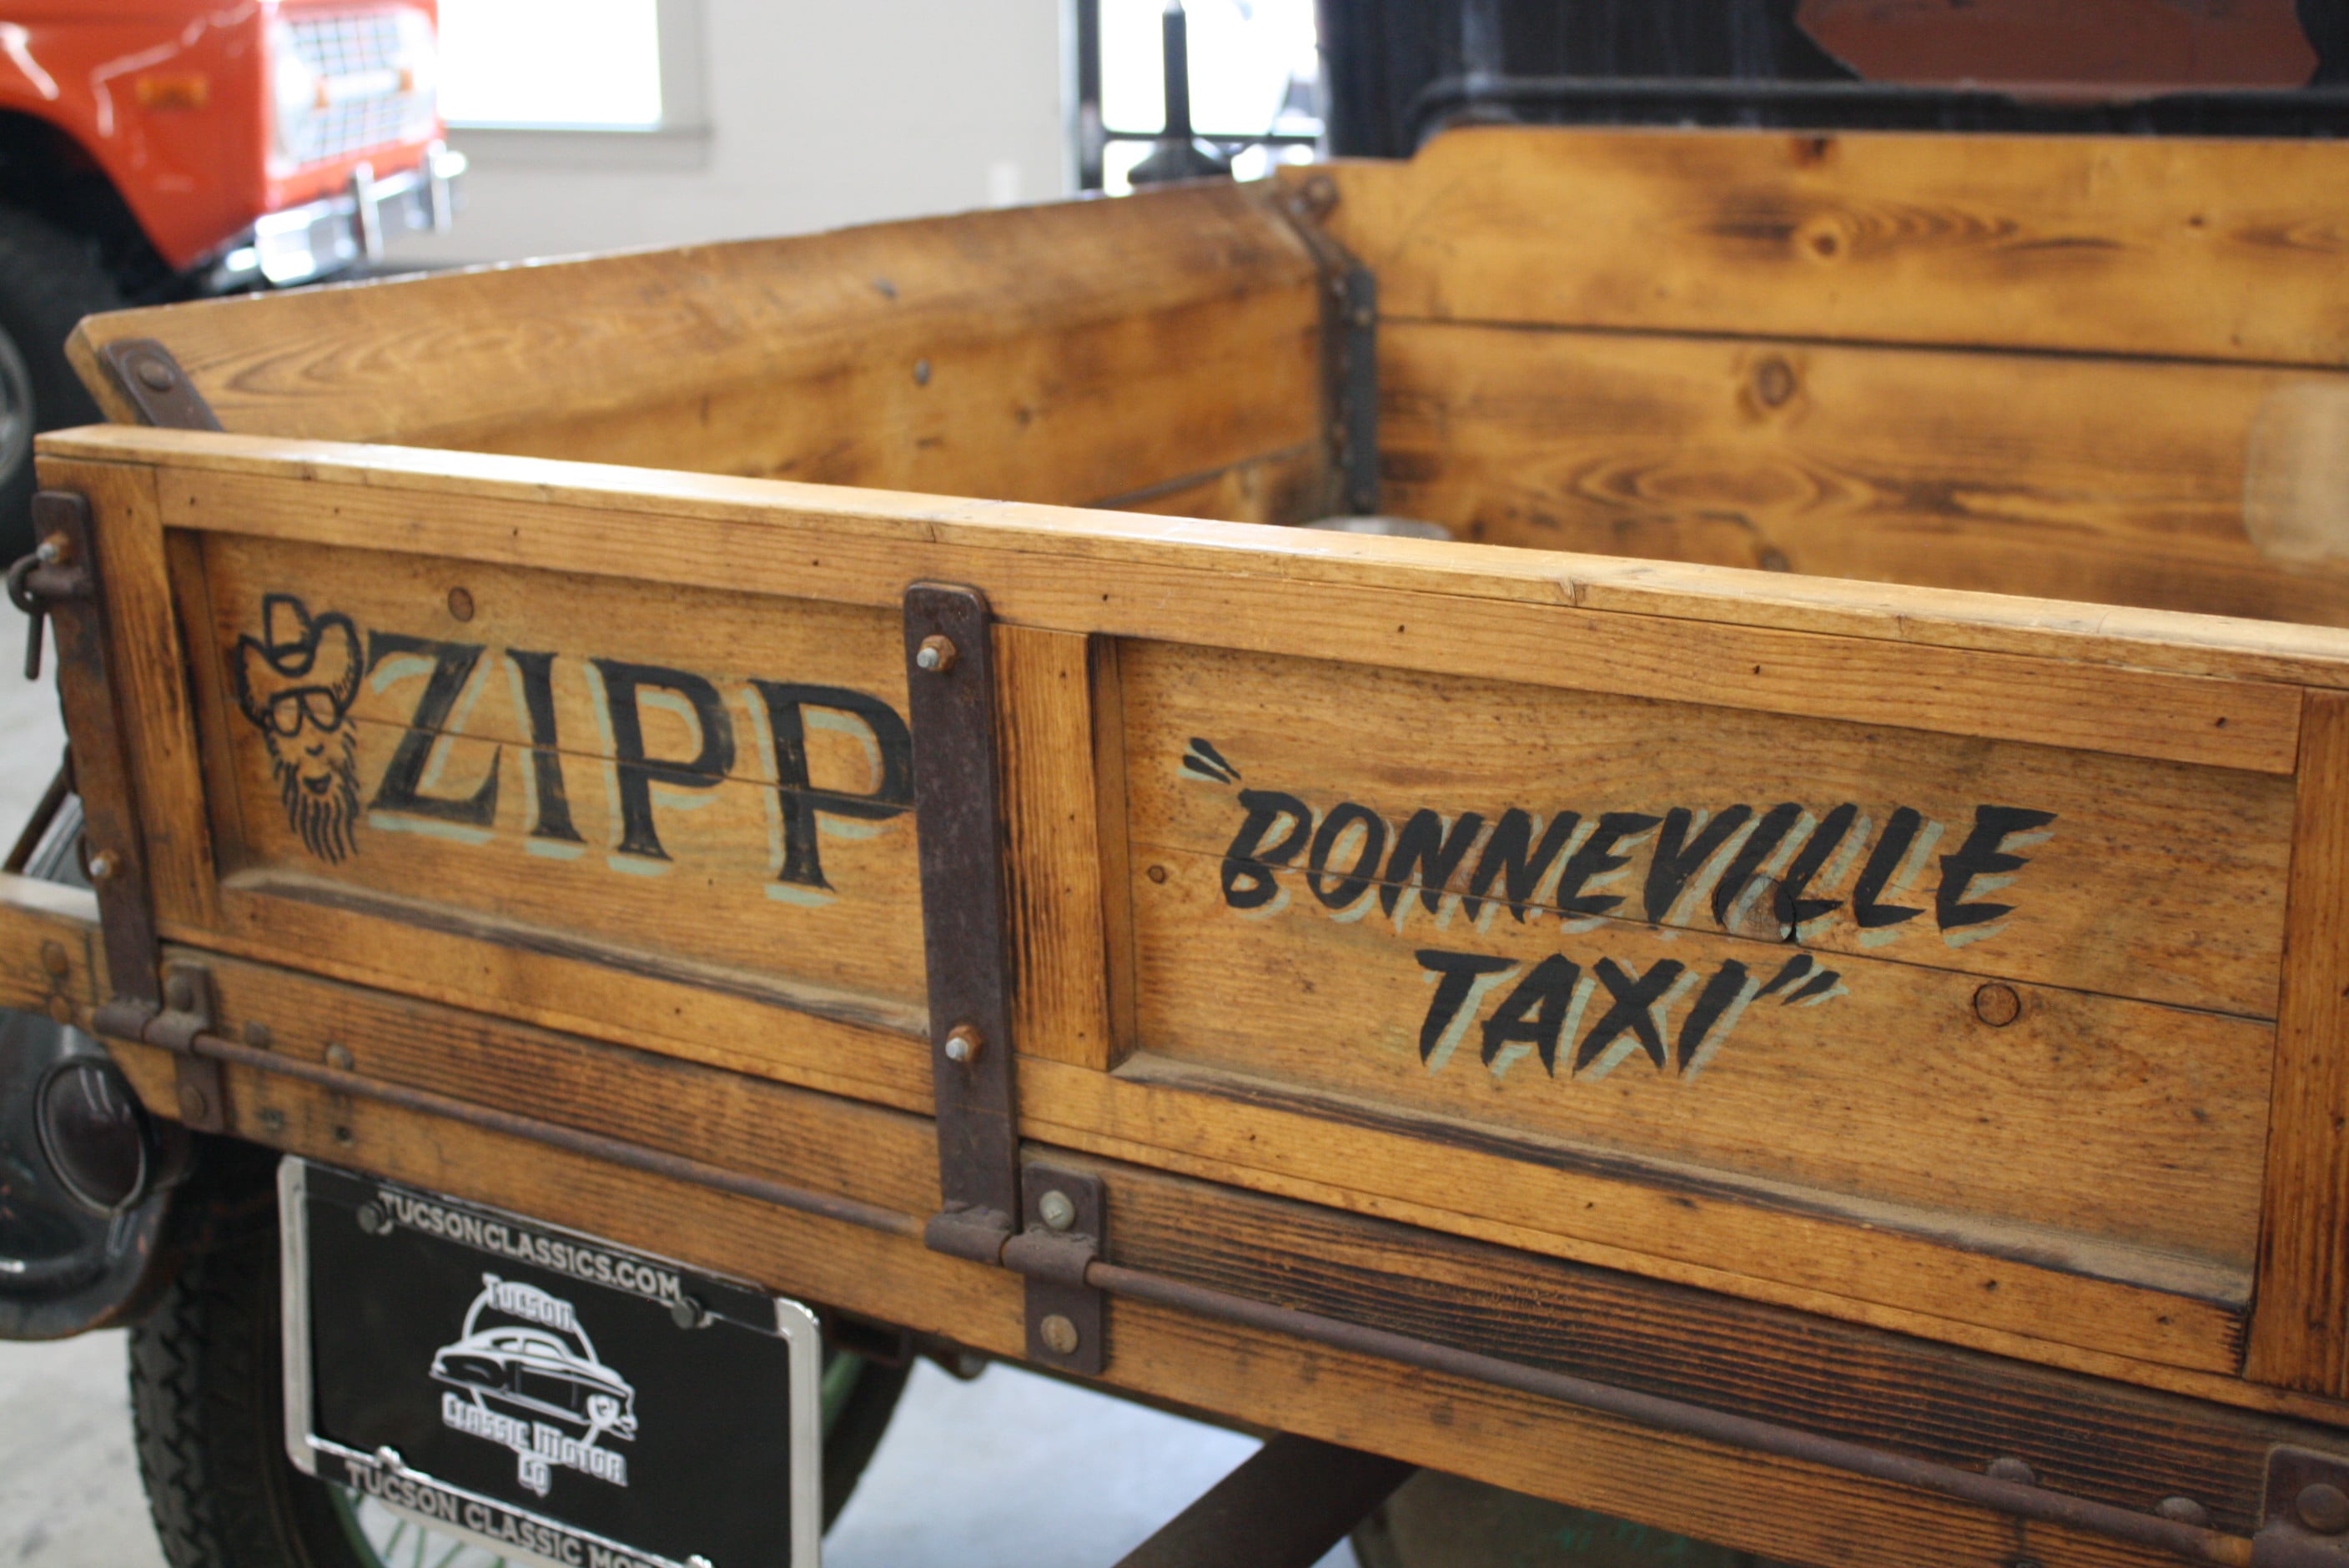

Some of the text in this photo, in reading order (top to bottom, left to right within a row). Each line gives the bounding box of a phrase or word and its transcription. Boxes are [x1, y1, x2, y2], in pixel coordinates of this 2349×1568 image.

[365, 631, 918, 896] ZIPP
[377, 1190, 682, 1300] TUCSONCLASSICS.COM
[345, 1460, 460, 1525] TUCSON
[465, 1505, 583, 1565] CLASSIC
